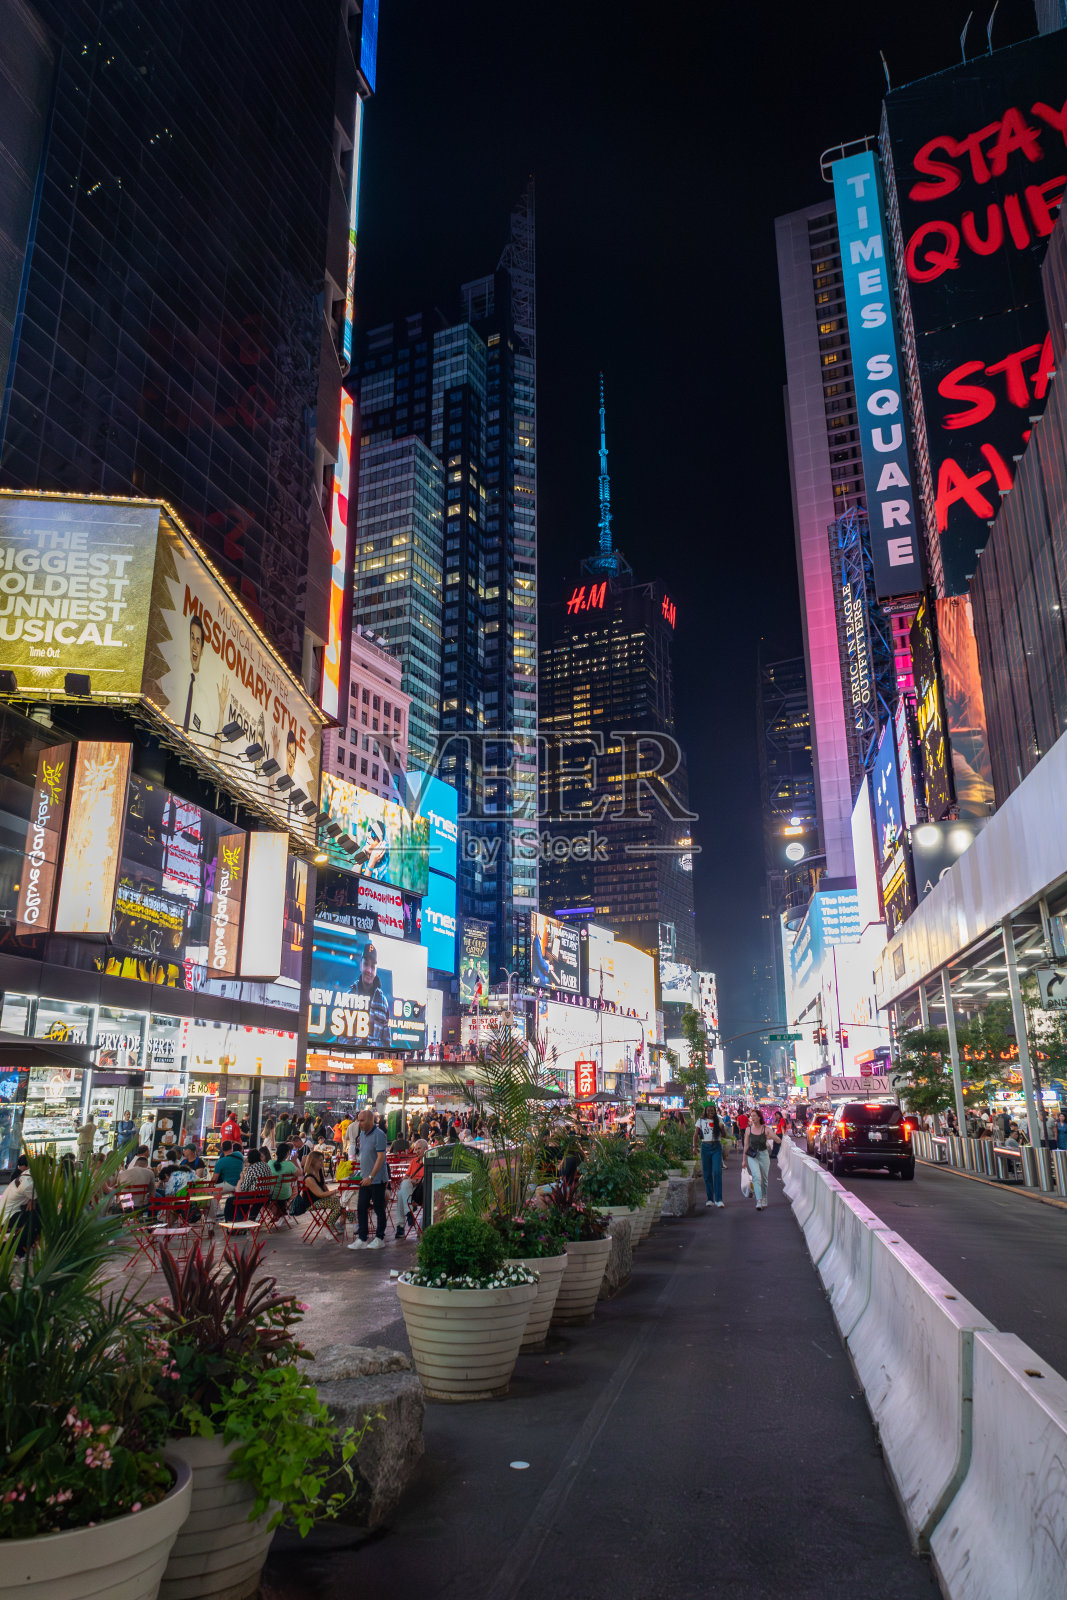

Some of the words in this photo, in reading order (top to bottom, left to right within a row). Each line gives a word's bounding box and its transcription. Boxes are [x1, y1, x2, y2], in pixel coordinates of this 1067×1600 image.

[846, 173, 887, 329] TIMES
[866, 353, 914, 567] SQUARE
[0, 547, 133, 579] IGGEST.
[567, 581, 607, 615] H&M
[661, 593, 677, 630] H&M
[842, 582, 855, 638] EAGLE
[29, 646, 45, 657] Time
[47, 647, 61, 658] Out
[183, 583, 272, 712] MISSIONARY
[217, 600, 255, 663] MUSICAL
[257, 650, 290, 704] THEATER
[853, 598, 871, 704] OUTFITTERS
[846, 641, 864, 730] AMERICAN
[28, 790, 51, 867] Garden
[24, 868, 41, 924] Olive
[214, 867, 231, 927] Garden
[213, 927, 227, 969] Olive
[330, 1007, 370, 1038] SYB
[580, 1062, 593, 1093] tkts
